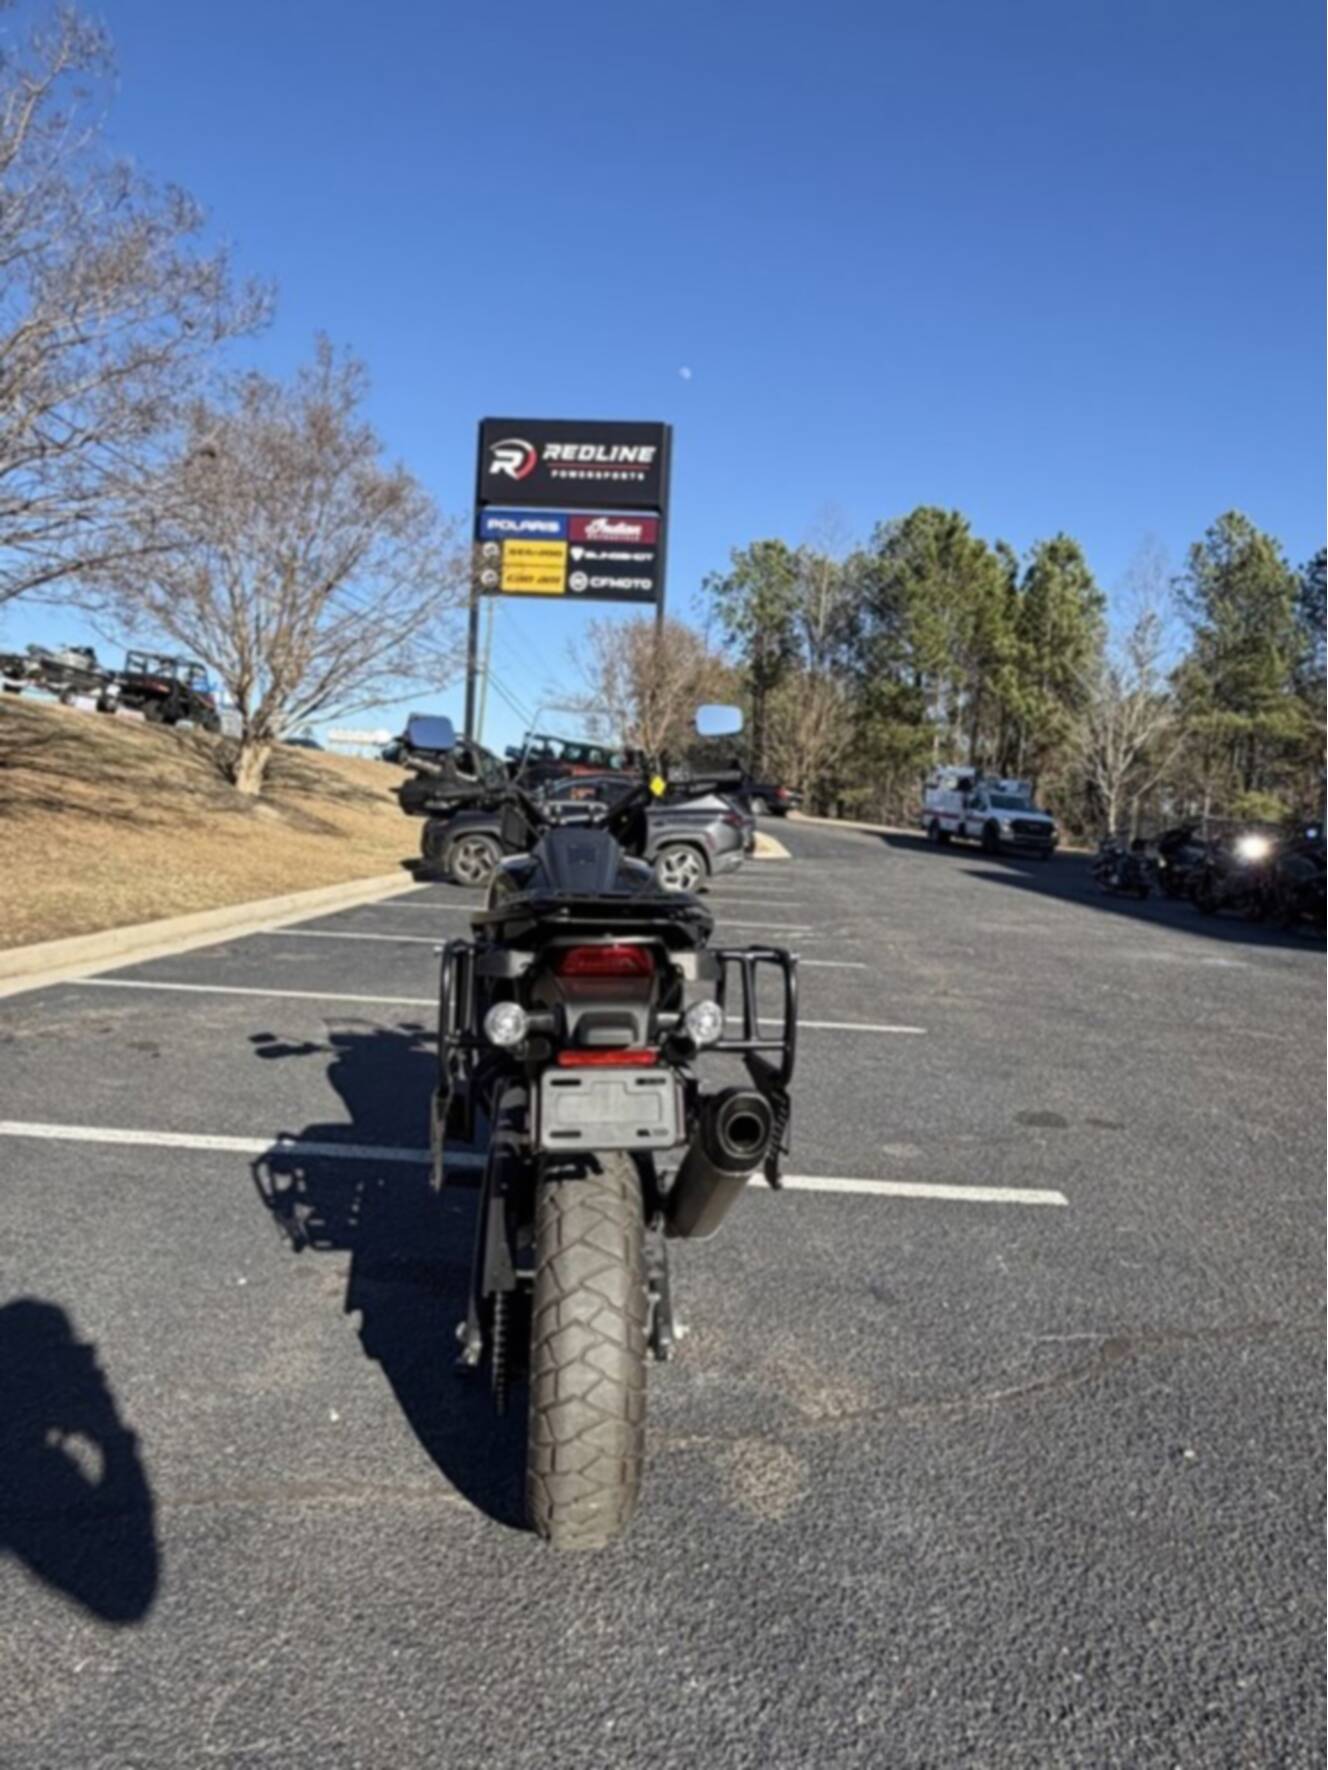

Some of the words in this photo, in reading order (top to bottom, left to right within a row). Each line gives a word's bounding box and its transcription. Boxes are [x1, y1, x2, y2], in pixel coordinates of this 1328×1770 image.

[542, 443, 656, 463] REDLINE
[487, 518, 560, 533] POLARIS
[590, 576, 653, 591] CFMOTO
